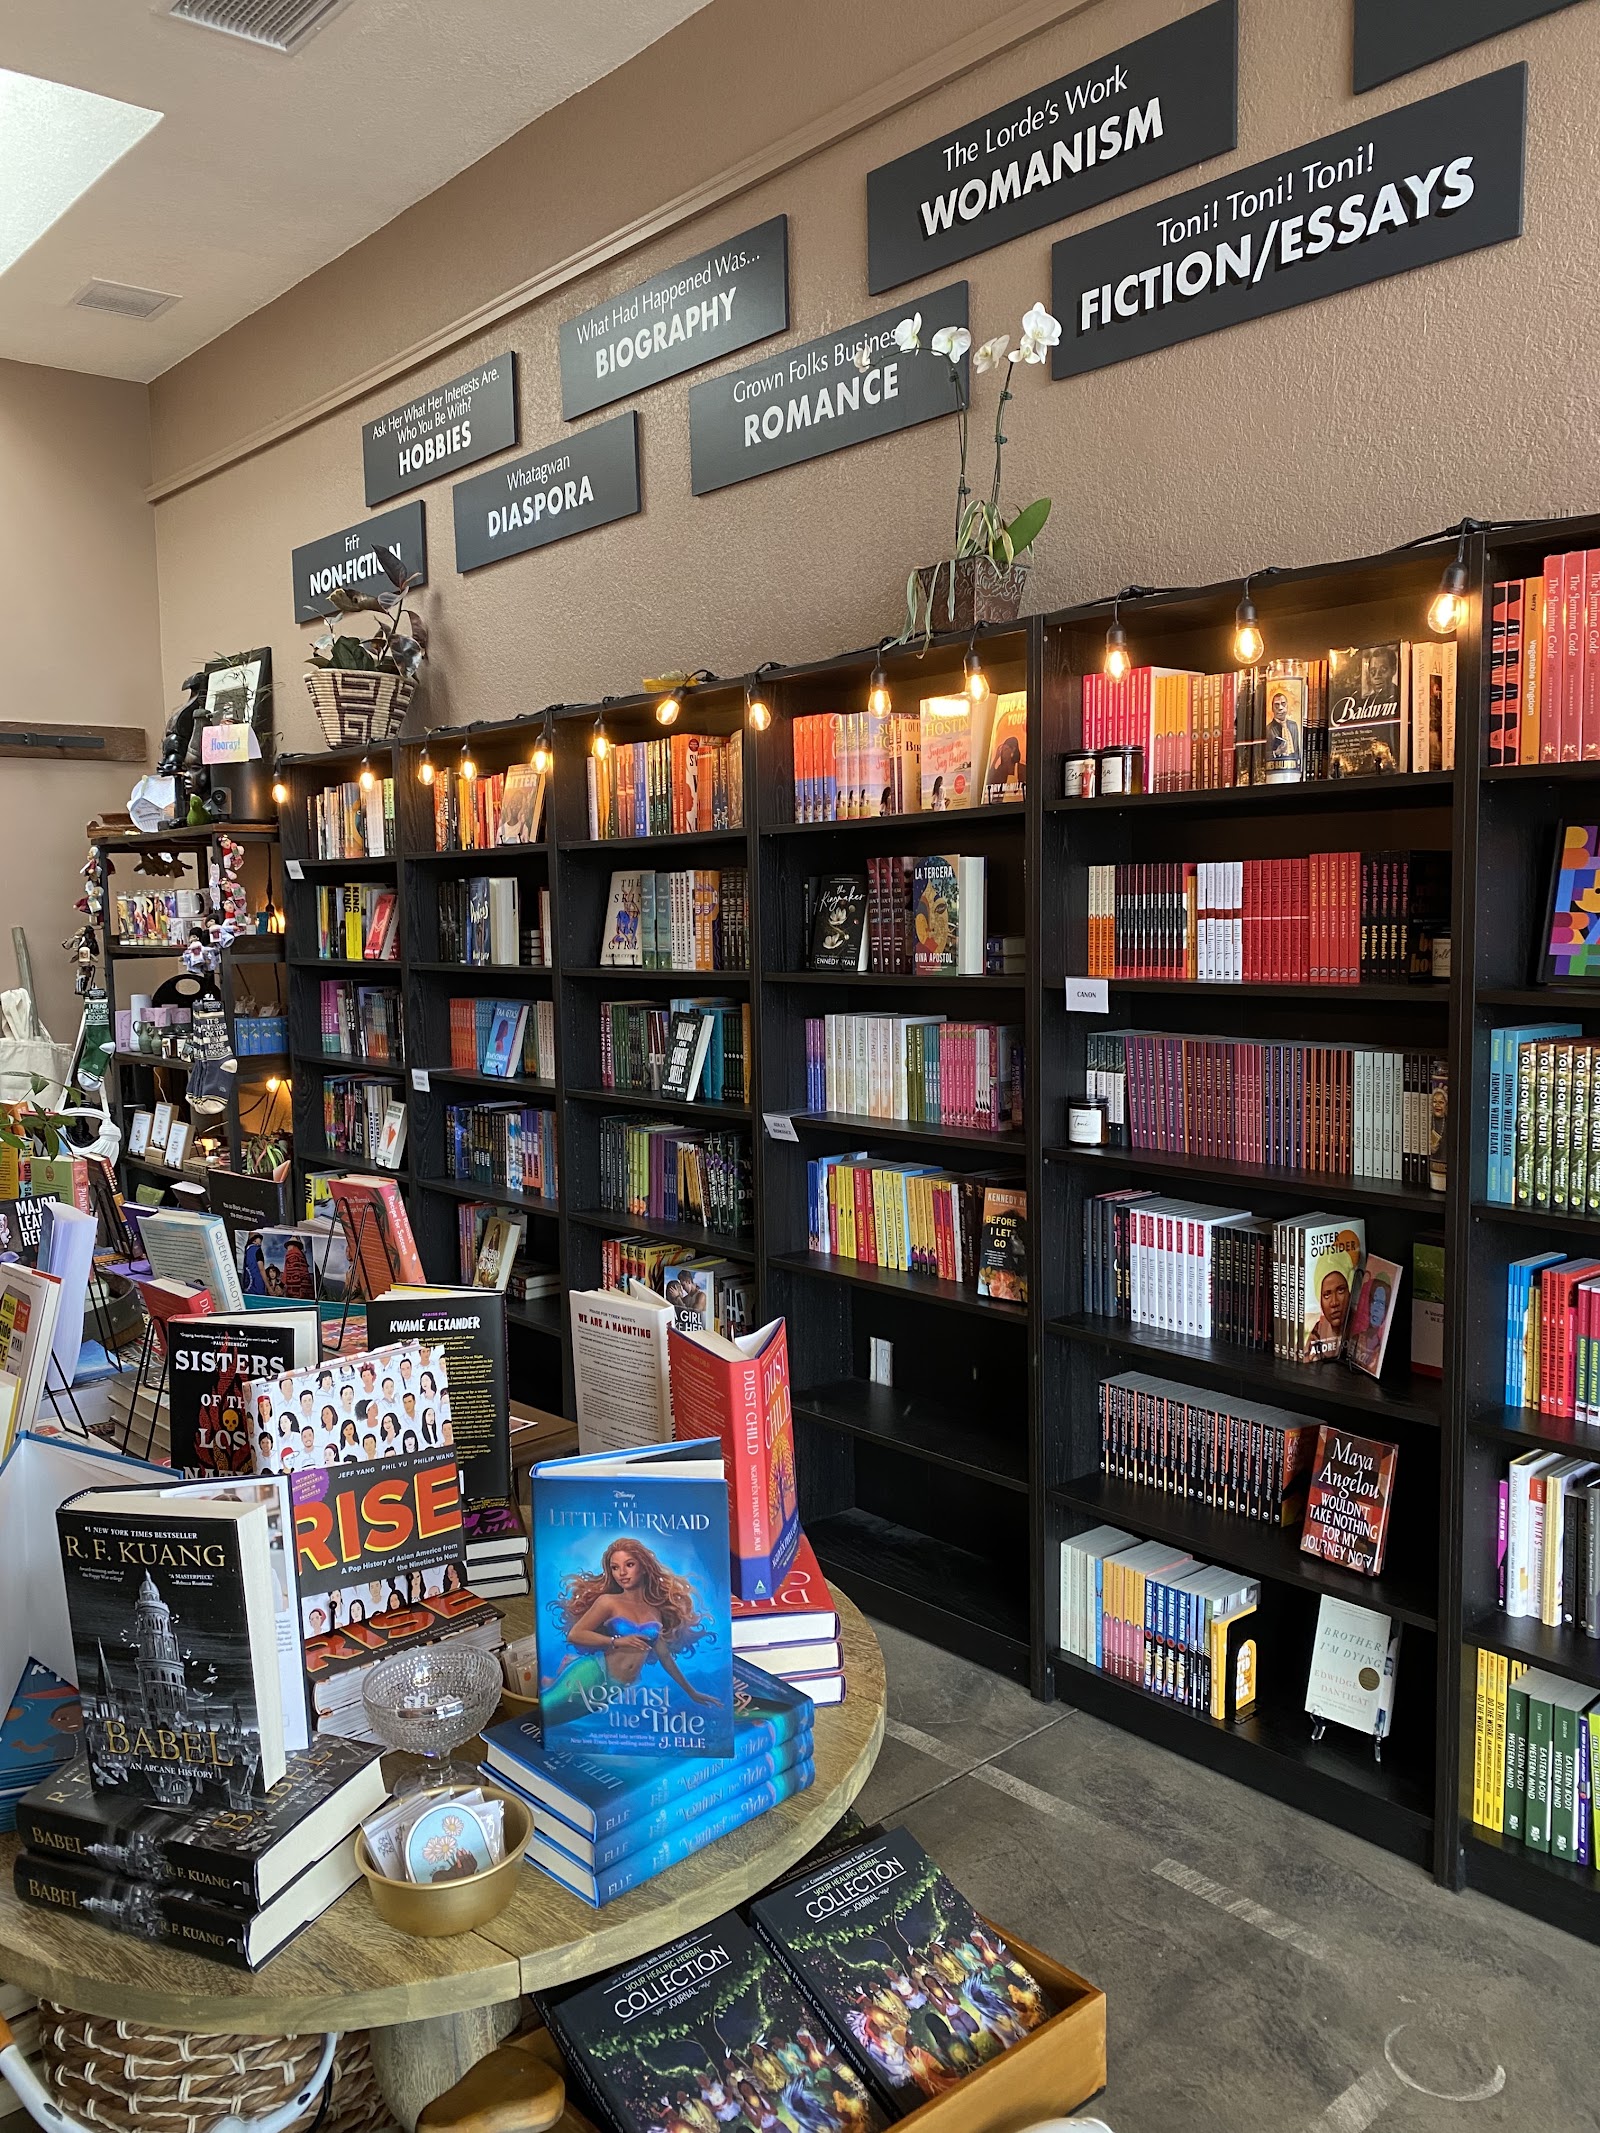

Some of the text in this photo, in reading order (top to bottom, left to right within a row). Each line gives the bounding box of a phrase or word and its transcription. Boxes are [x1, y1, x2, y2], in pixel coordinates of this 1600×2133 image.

[943, 65, 1128, 172] The Lorde's Work
[921, 97, 1164, 236] WOMANISM
[1157, 142, 1374, 247] Toni! Toni! Toni!
[1081, 156, 1475, 330] FICTION/ESSAYS
[577, 252, 760, 344] What Had Happened Was...
[596, 287, 737, 378] BIOGRAPHY
[733, 328, 898, 403] Grown Folks Busines
[372, 368, 500, 440] Ask Her What Her Interests Are.
[397, 396, 472, 445] Who You Be With?
[744, 363, 899, 447] ROMANCE
[399, 421, 472, 476] HOBBIES
[507, 456, 570, 491] Whatagwan
[488, 475, 594, 538] DIASPORA
[345, 534, 359, 553] FrFr
[1547, 578, 1559, 659] The Jemima Code
[1527, 640, 1537, 716] Vegetable Kingdom
[1331, 689, 1397, 727] Baldwin
[211, 737, 240, 751] Hooray!
[915, 866, 953, 879] LA TERCERA
[820, 885, 865, 912] Kingmaker
[915, 953, 952, 964] GINA APOSTOL
[1520, 1050, 1530, 1144] YOU GROW GURL!
[1073, 1115, 1089, 1128] Toni
[1503, 1074, 1513, 1157] FARMING WHILE BLACK
[988, 1193, 1017, 1204] KENNEDY
[388, 1195, 397, 1218] Recipe
[397, 1230, 407, 1255] Success
[986, 1216, 1017, 1227] BEFORE
[990, 1227, 1011, 1237] I LET
[215, 1231, 229, 1262] QUEEN
[994, 1239, 1006, 1248] GO
[1311, 1232, 1339, 1246] SISTER
[1311, 1241, 1356, 1258] OUTSIDER
[390, 1316, 480, 1333] KWAME ALEXANDER
[578, 1313, 587, 1323] WE
[591, 1317, 602, 1328] ARE
[606, 1320, 610, 1329] A
[175, 1350, 285, 1376] SISTERS
[764, 1344, 785, 1406] DUST
[200, 1394, 245, 1409] OF TH
[743, 1370, 759, 1455] DUST CHILD
[765, 1385, 791, 1450] CHILD
[198, 1428, 246, 1450] LOS
[338, 1471, 354, 1479] JEFF
[357, 1467, 375, 1475] YANG
[413, 1457, 434, 1465] PHILIP
[436, 1452, 454, 1460] WANG
[1331, 1438, 1374, 1475] Maya
[613, 1490, 635, 1500] Disney
[1318, 1461, 1379, 1500] Angelou
[293, 1463, 462, 1576] RISE
[1309, 1504, 1378, 1539] TAKE NOTHING
[1321, 1492, 1370, 1520] WOULDN'T
[93, 1526, 109, 1535] NEW
[110, 1528, 129, 1537] YORK
[130, 1529, 153, 1539] TIMES
[154, 1531, 198, 1540] BESTSELLER
[550, 1509, 710, 1537] LITTLE MERMAID
[1322, 1524, 1358, 1549] FOR MY
[64, 1535, 226, 1568] R. F. KUANG
[348, 1565, 361, 1573] Pop
[363, 1560, 386, 1569] History
[396, 1554, 414, 1562] Asian
[416, 1548, 441, 1557] America
[443, 1544, 458, 1552] from
[409, 1558, 435, 1568] Nineties
[444, 1552, 458, 1560] Now
[1304, 1534, 1346, 1560] JOURNEY
[305, 1587, 489, 1673] RISE
[1324, 1627, 1386, 1653] BROTHER,
[1319, 1641, 1383, 1670] I'M DYING
[1314, 1669, 1358, 1690] EDWIDGE
[1320, 1683, 1370, 1708] DANTICAT
[566, 1680, 671, 1714] Against
[609, 1706, 705, 1735] the Tide
[104, 1720, 234, 1766] BABEL
[659, 1737, 671, 1749] J.
[674, 1736, 706, 1749] ELLE
[130, 1762, 214, 1779] AN ARCANE HISTORY
[1528, 1743, 1537, 1800] WESTERN MIND
[1539, 1747, 1547, 1783] EASTERN
[606, 1809, 631, 1831] ELLE
[31, 1826, 88, 1857] BABEL
[187, 1869, 231, 1890] KUANG
[806, 1857, 905, 1918] COLLECTION
[813, 1858, 880, 1896] YOUR HEALING HERBAL
[853, 1893, 880, 1912] JOURNAL
[614, 1945, 729, 2018] COLLECTION
[755, 1922, 866, 2075] Your Healing Herbal Collection Journal
